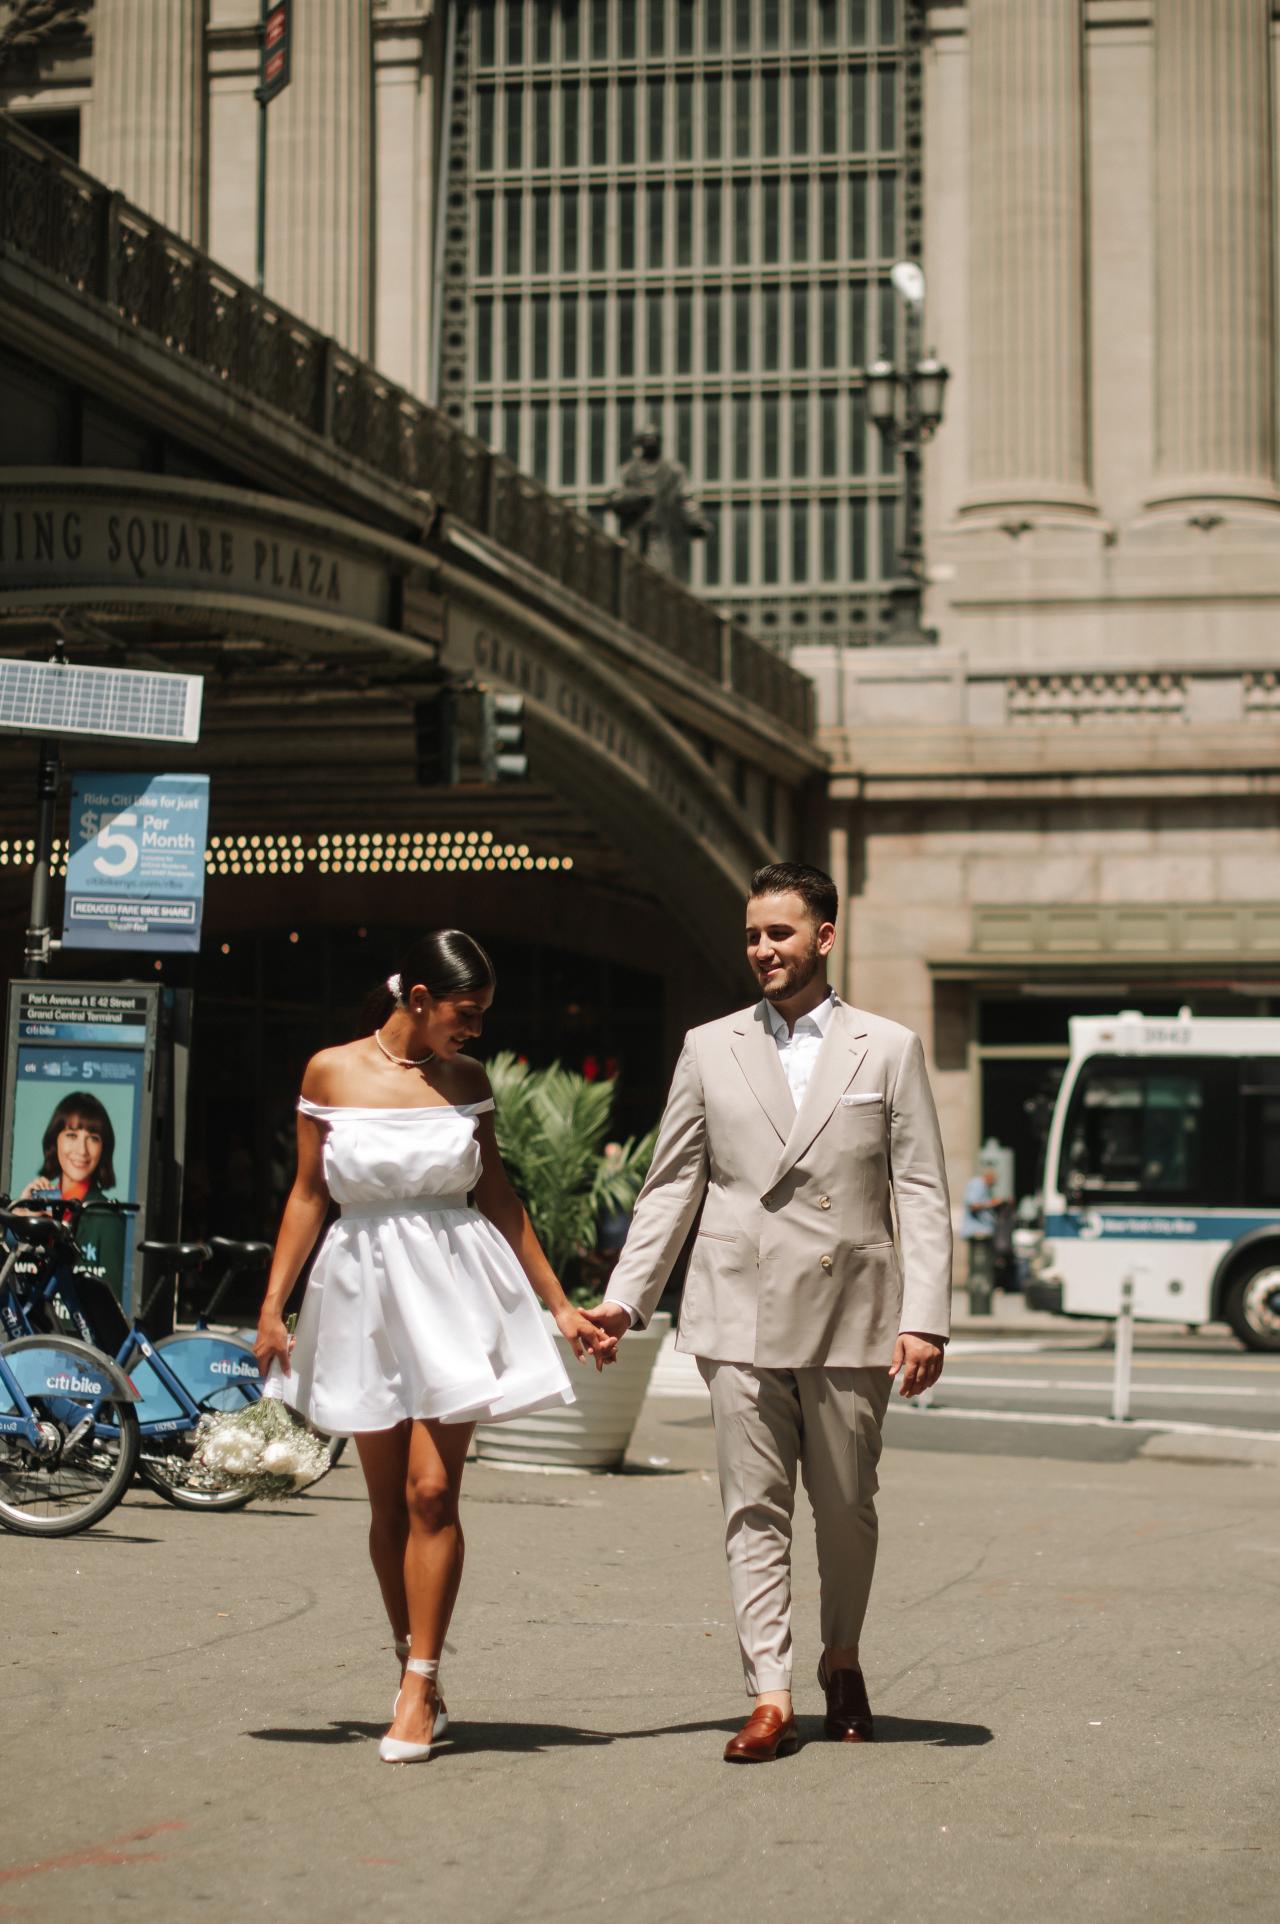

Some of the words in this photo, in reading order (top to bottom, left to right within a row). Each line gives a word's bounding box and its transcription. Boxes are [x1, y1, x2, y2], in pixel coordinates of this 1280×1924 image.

[0, 511, 82, 562] ING
[107, 514, 234, 578] SQUARE
[253, 538, 341, 601] PLAZA
[84, 793, 109, 805] Ride
[111, 793, 131, 806] Citi
[160, 795, 176, 808] for
[176, 795, 199, 811] just
[143, 814, 169, 830] Per
[142, 832, 195, 849] Month
[75, 903, 117, 915] REDUCED
[117, 904, 140, 916] FARE
[140, 905, 161, 917] BIKE
[161, 906, 191, 918] SHARE
[28, 993, 48, 1005] Park
[49, 994, 80, 1006] Avenue
[90, 996, 96, 1007] E
[109, 997, 135, 1009] Street
[27, 1009, 53, 1020] Grand
[55, 1010, 85, 1022] Central
[86, 1012, 122, 1023] Terminal
